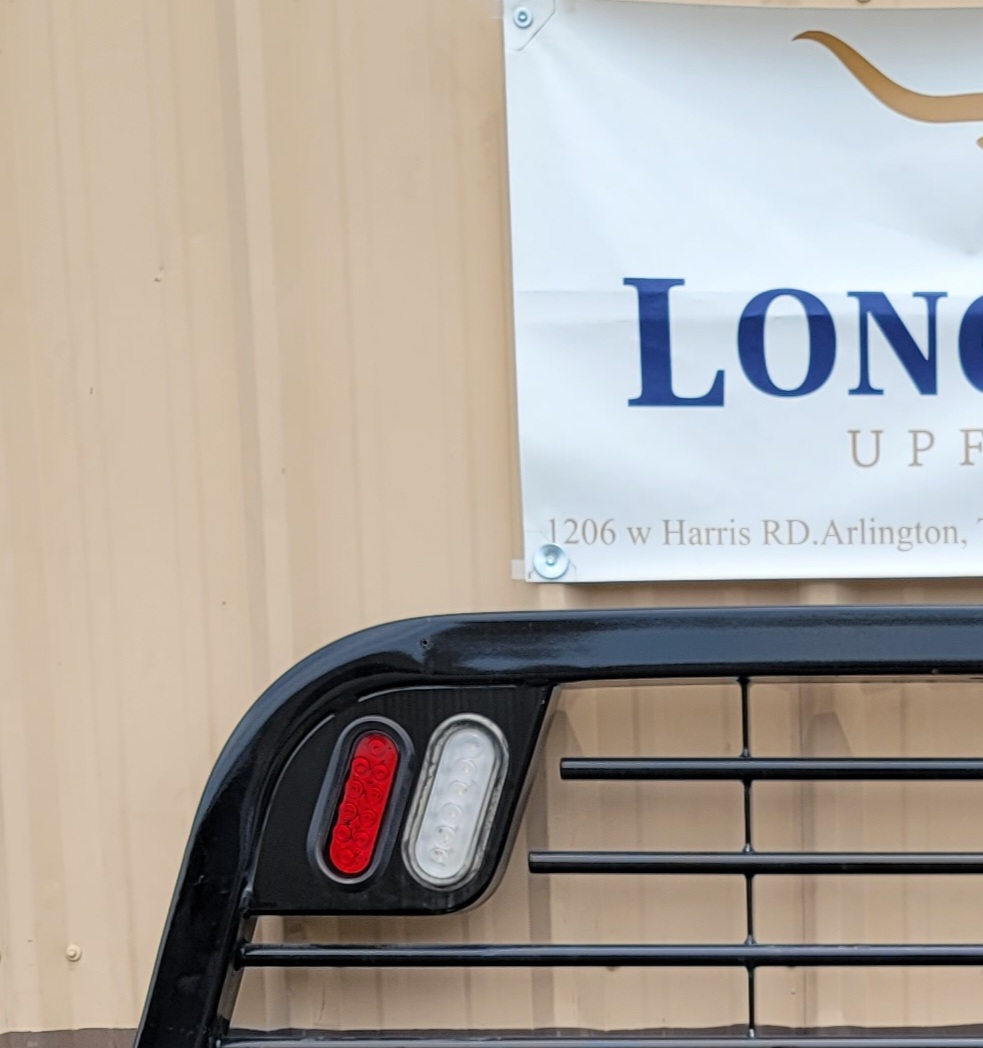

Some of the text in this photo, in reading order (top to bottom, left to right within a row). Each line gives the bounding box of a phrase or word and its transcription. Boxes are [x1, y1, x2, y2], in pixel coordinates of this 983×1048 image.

[549, 517, 616, 546] 1206
[627, 525, 651, 546] w
[662, 517, 751, 546] Harris
